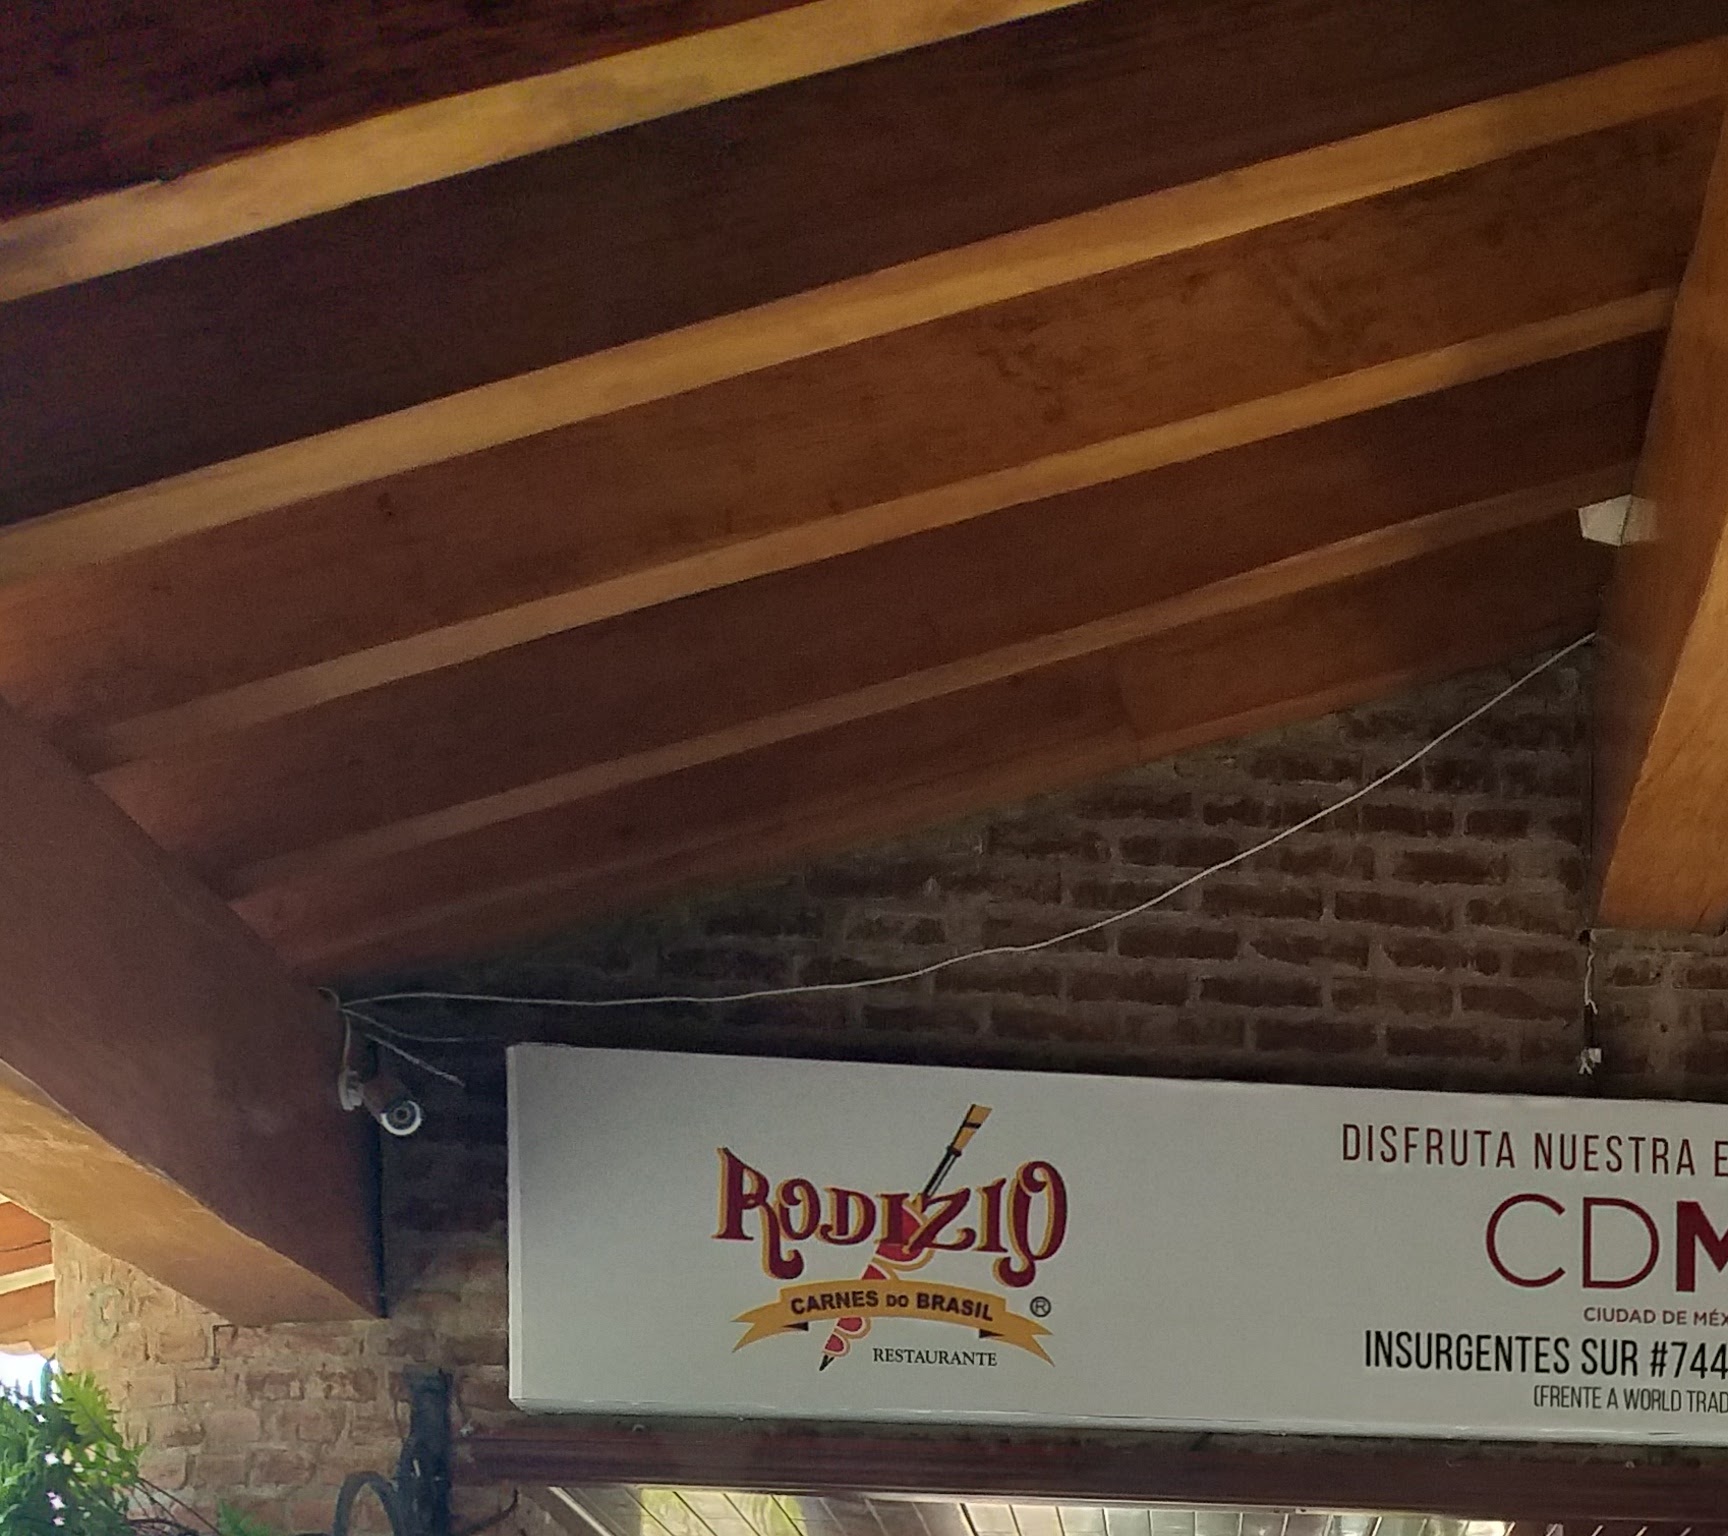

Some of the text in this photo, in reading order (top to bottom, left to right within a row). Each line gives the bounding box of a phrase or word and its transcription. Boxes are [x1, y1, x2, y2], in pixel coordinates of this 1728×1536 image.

[1342, 1123, 1516, 1169] DISFRUTA
[1533, 1132, 1696, 1177] NUESTRA
[711, 1147, 1068, 1288] RODIZIO
[790, 1290, 879, 1315] CARNES
[916, 1293, 993, 1322] BRASIL
[1583, 1306, 1657, 1325] CIUDAD
[1662, 1310, 1687, 1325] DE
[872, 1347, 998, 1367] RESTAURANTE
[1364, 1329, 1570, 1375] INSURGENTES
[1581, 1338, 1639, 1378] SUR
[1533, 1384, 1602, 1409] (FRENTE
[1606, 1387, 1619, 1410] A
[1623, 1388, 1682, 1412] WORLD
